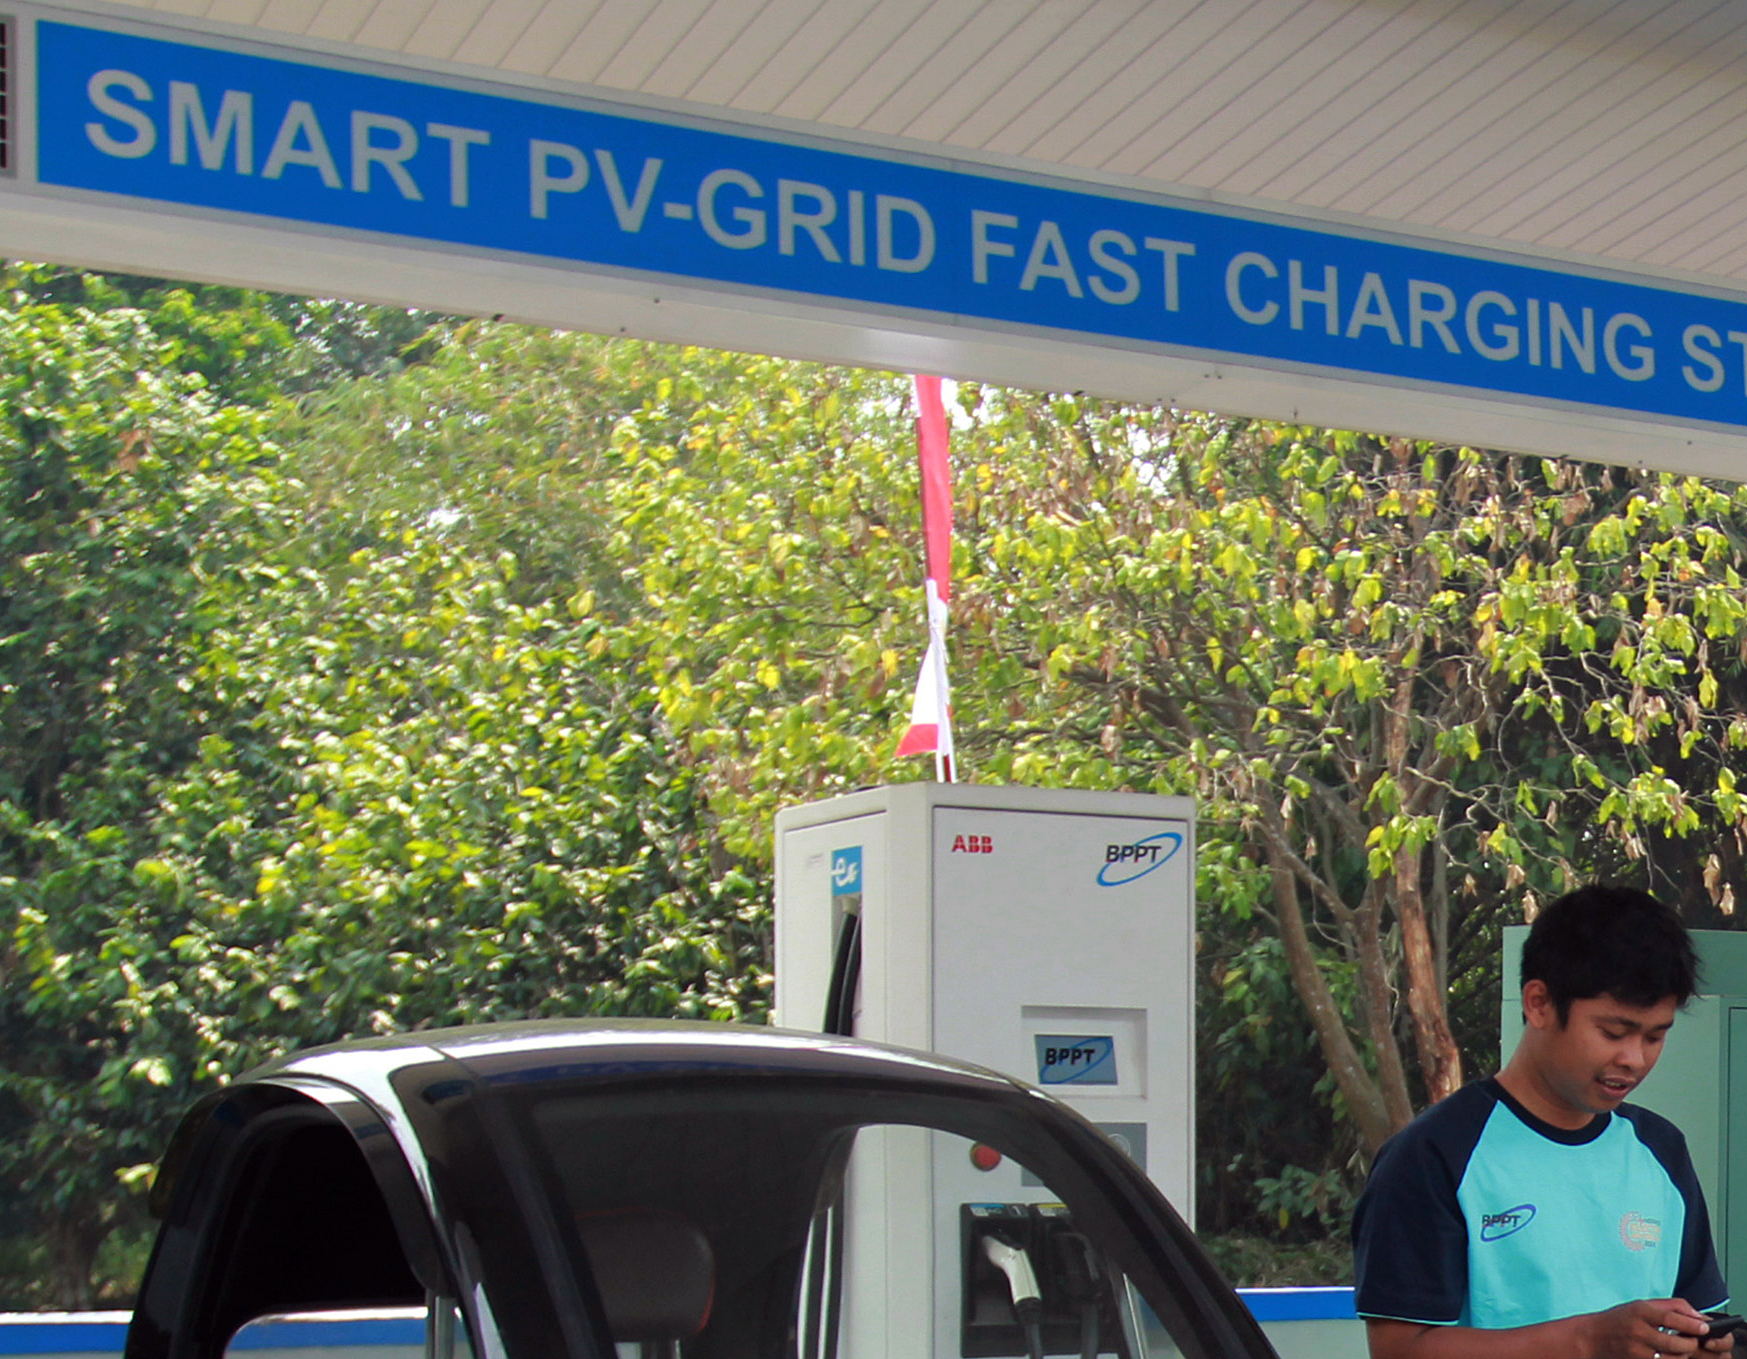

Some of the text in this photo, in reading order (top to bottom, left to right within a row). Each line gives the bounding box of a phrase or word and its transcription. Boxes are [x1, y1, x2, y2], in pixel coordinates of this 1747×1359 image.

[85, 69, 490, 207] SMART
[528, 138, 937, 274] PV-GRID
[970, 209, 1196, 312] FAST
[1225, 252, 1655, 382] CHARGING
[952, 835, 993, 853] ABB
[1105, 844, 1161, 863] BPPT
[1045, 1048, 1095, 1066] BPPT
